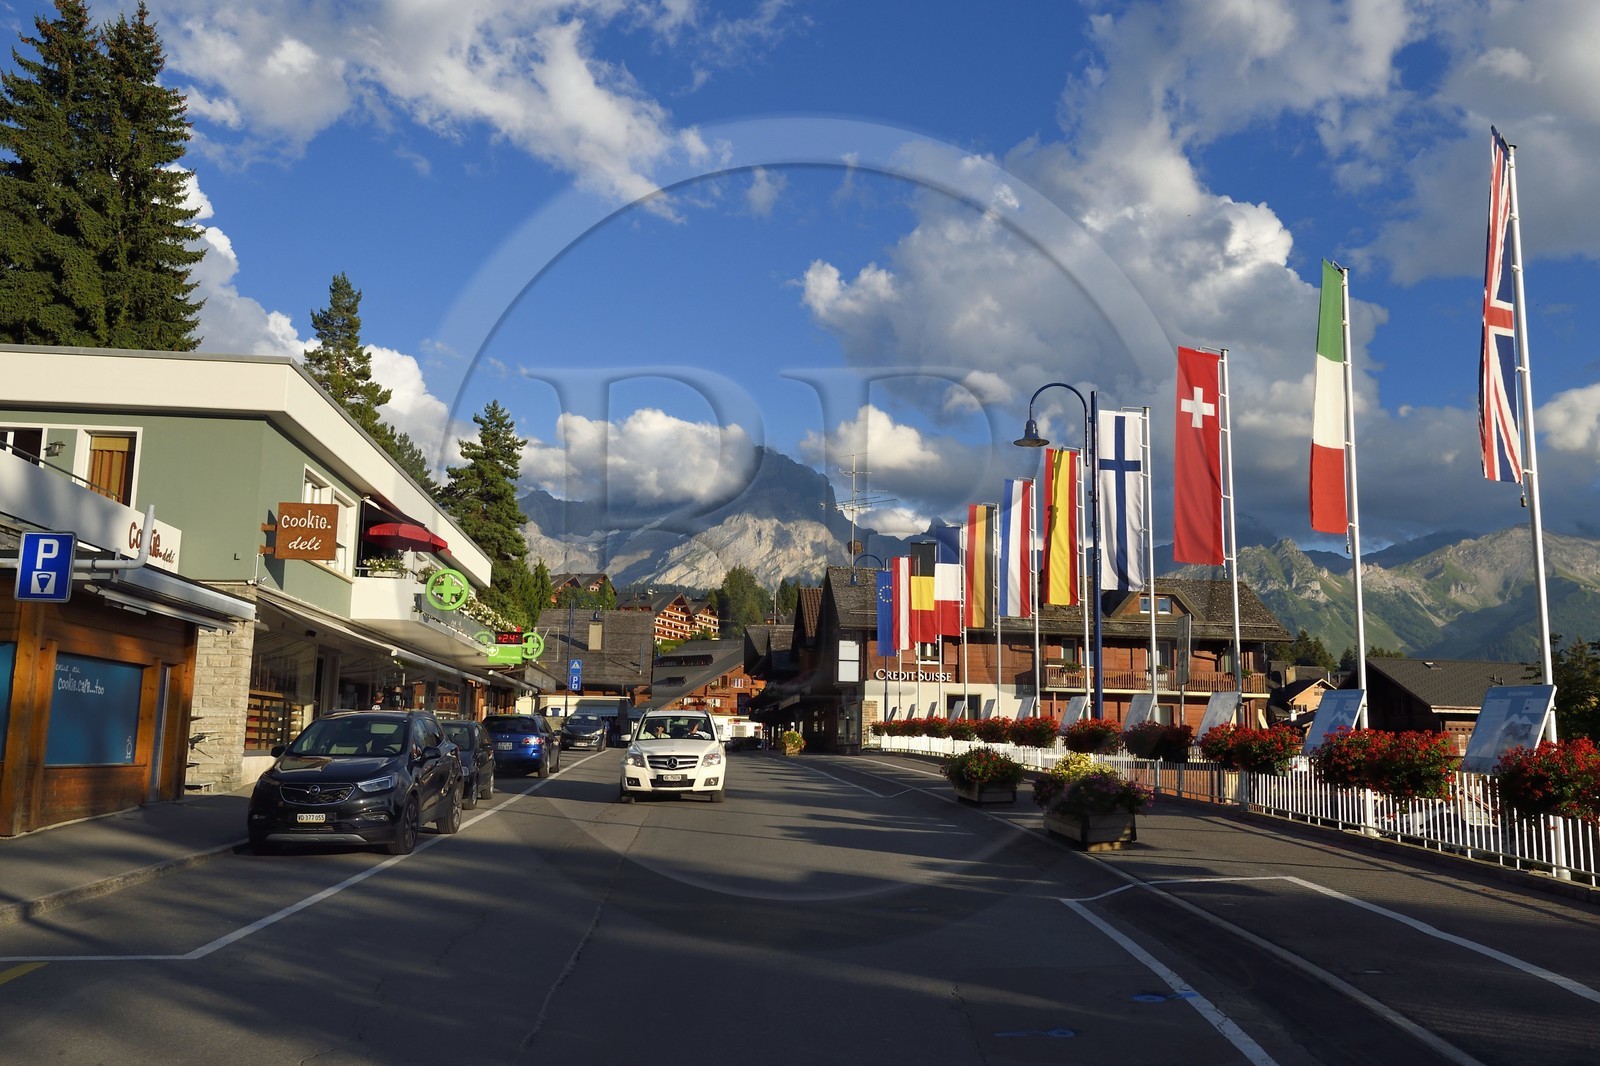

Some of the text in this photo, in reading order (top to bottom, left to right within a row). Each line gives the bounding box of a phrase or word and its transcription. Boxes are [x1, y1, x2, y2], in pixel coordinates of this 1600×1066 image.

[288, 536, 322, 551] deli
[35, 538, 60, 570] P
[572, 676, 578, 684] P
[875, 668, 952, 681] CREDIT SUISSE
